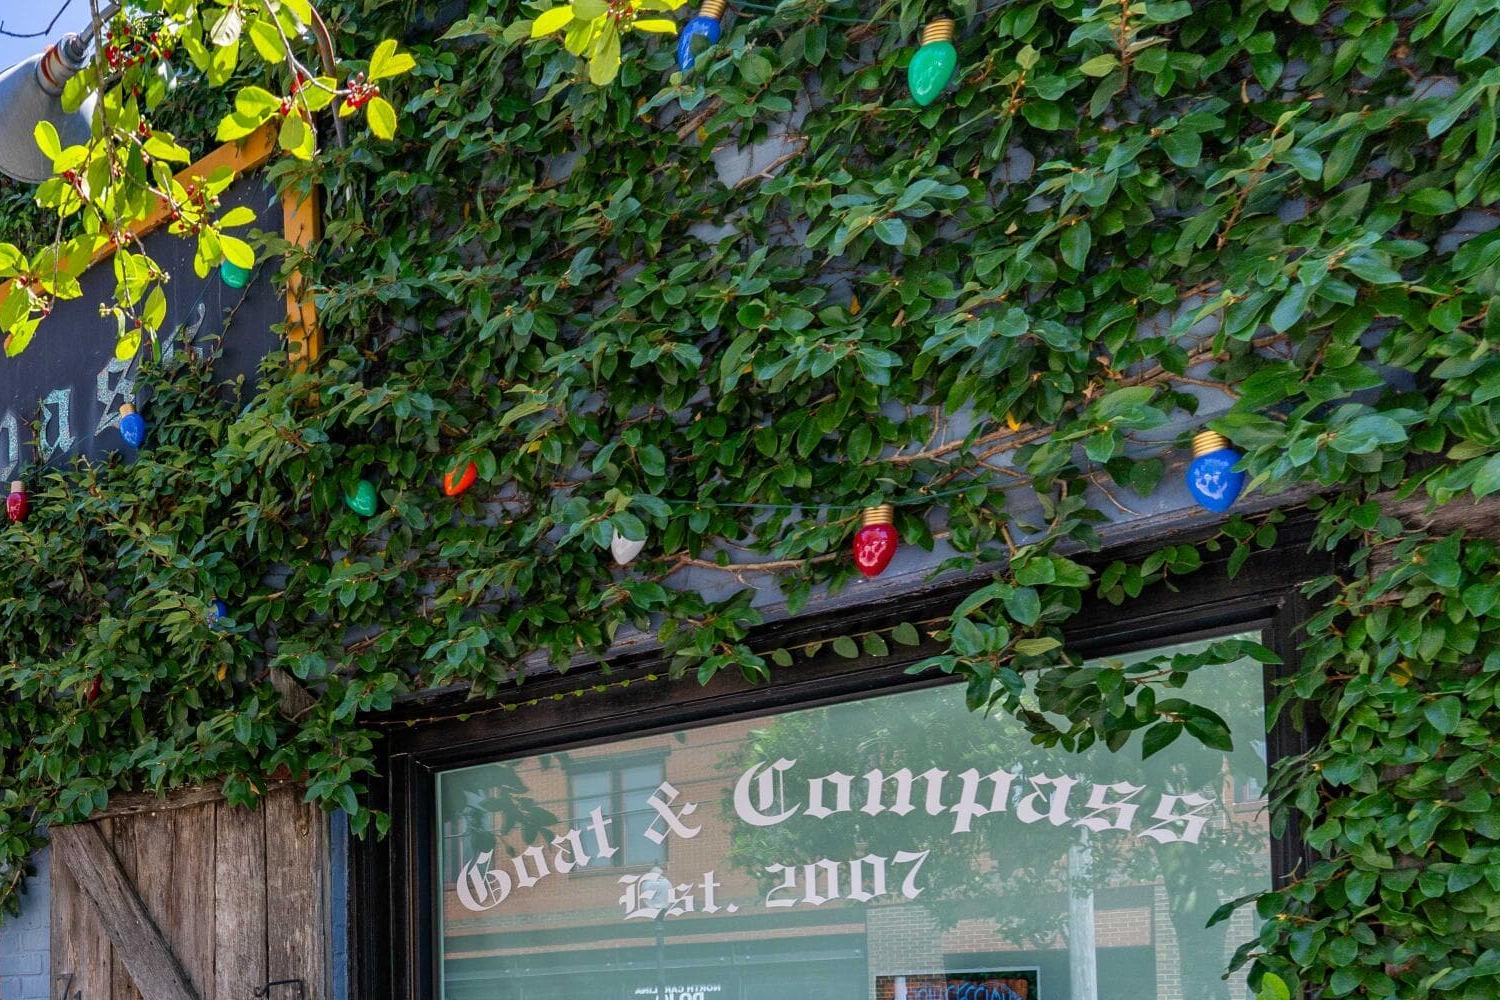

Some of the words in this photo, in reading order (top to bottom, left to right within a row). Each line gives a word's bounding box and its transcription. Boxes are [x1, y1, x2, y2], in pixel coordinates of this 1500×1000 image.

[456, 805, 620, 912] Goat
[643, 781, 702, 845] &
[733, 757, 1217, 845] Compass
[618, 869, 740, 920] Est.
[764, 848, 931, 908] 2007
